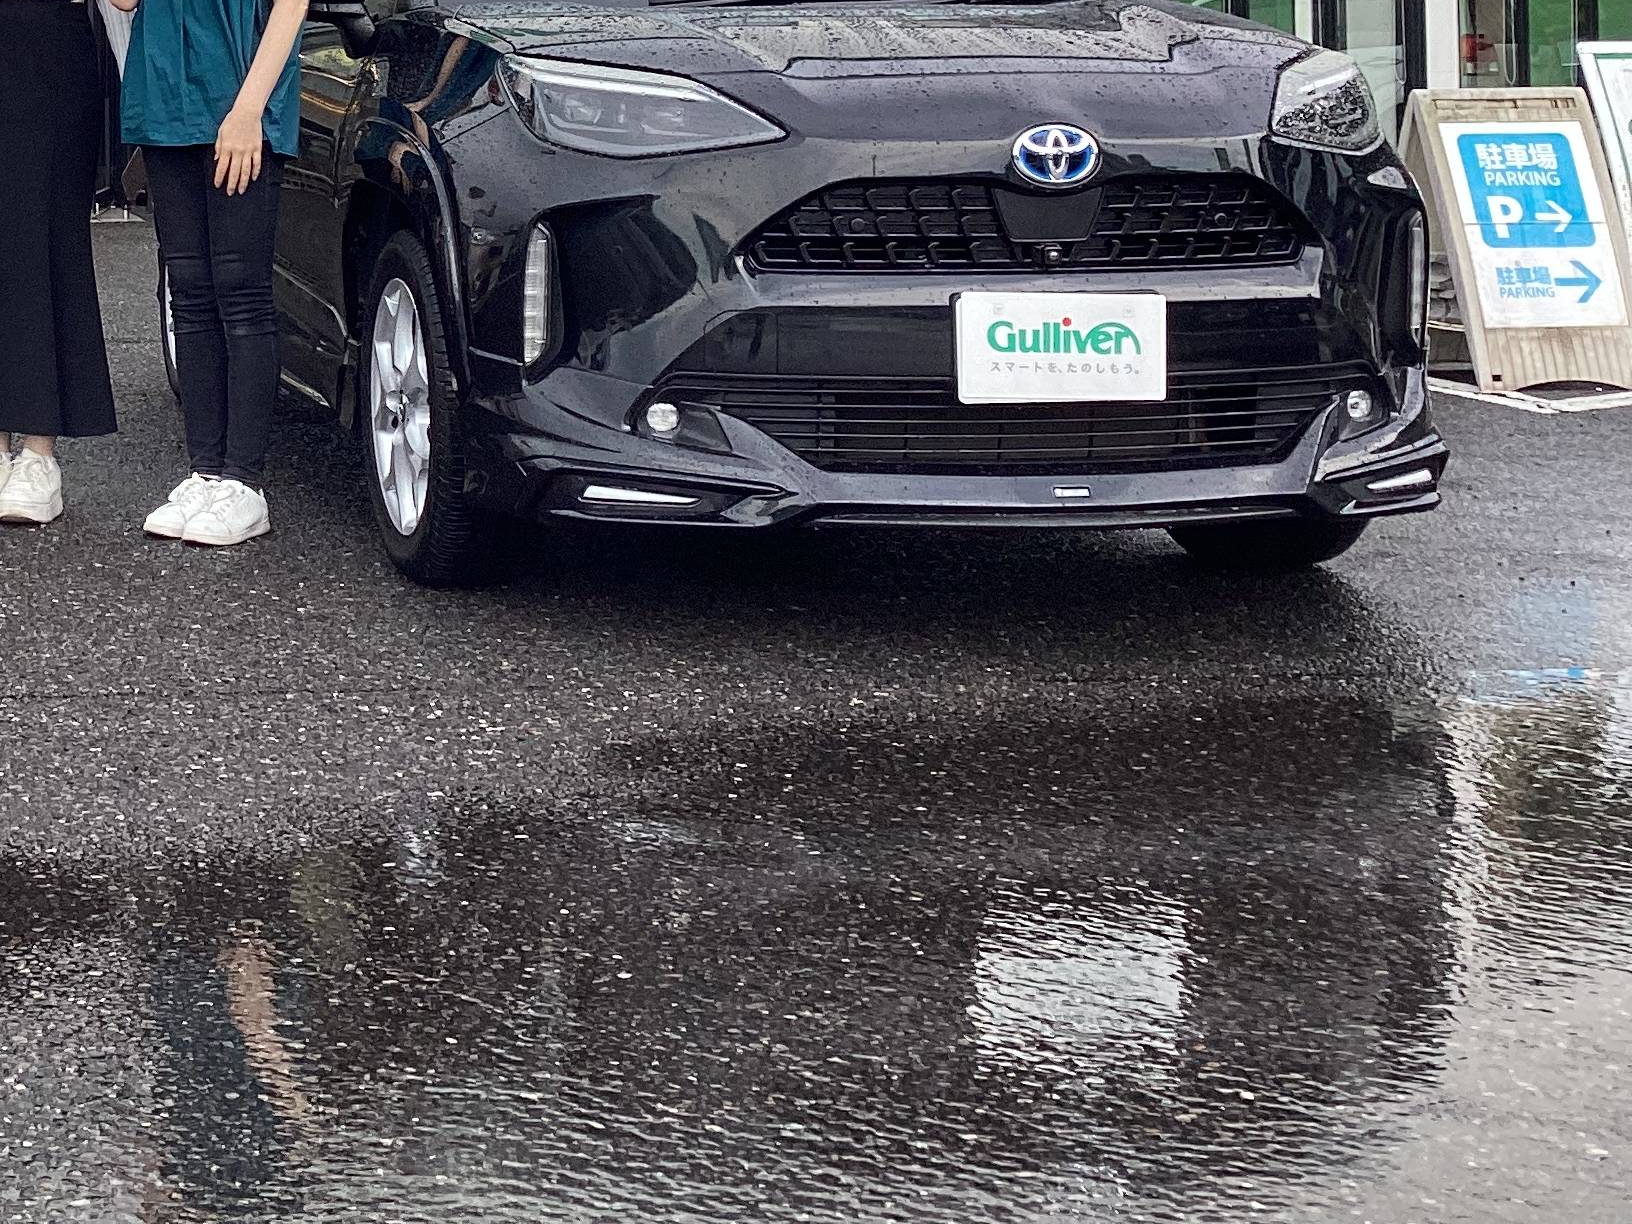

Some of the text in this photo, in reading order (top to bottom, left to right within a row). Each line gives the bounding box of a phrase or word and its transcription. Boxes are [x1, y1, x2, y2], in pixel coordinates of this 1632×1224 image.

[1475, 143, 1557, 170] 駐車場
[1484, 171, 1561, 187] PARKING
[1487, 195, 1523, 239] P
[1496, 266, 1552, 286] 駐車場
[1499, 287, 1556, 299] PARKING
[987, 317, 1141, 355] Gulliver
[990, 361, 1139, 375] スマートを、たのしもう。
